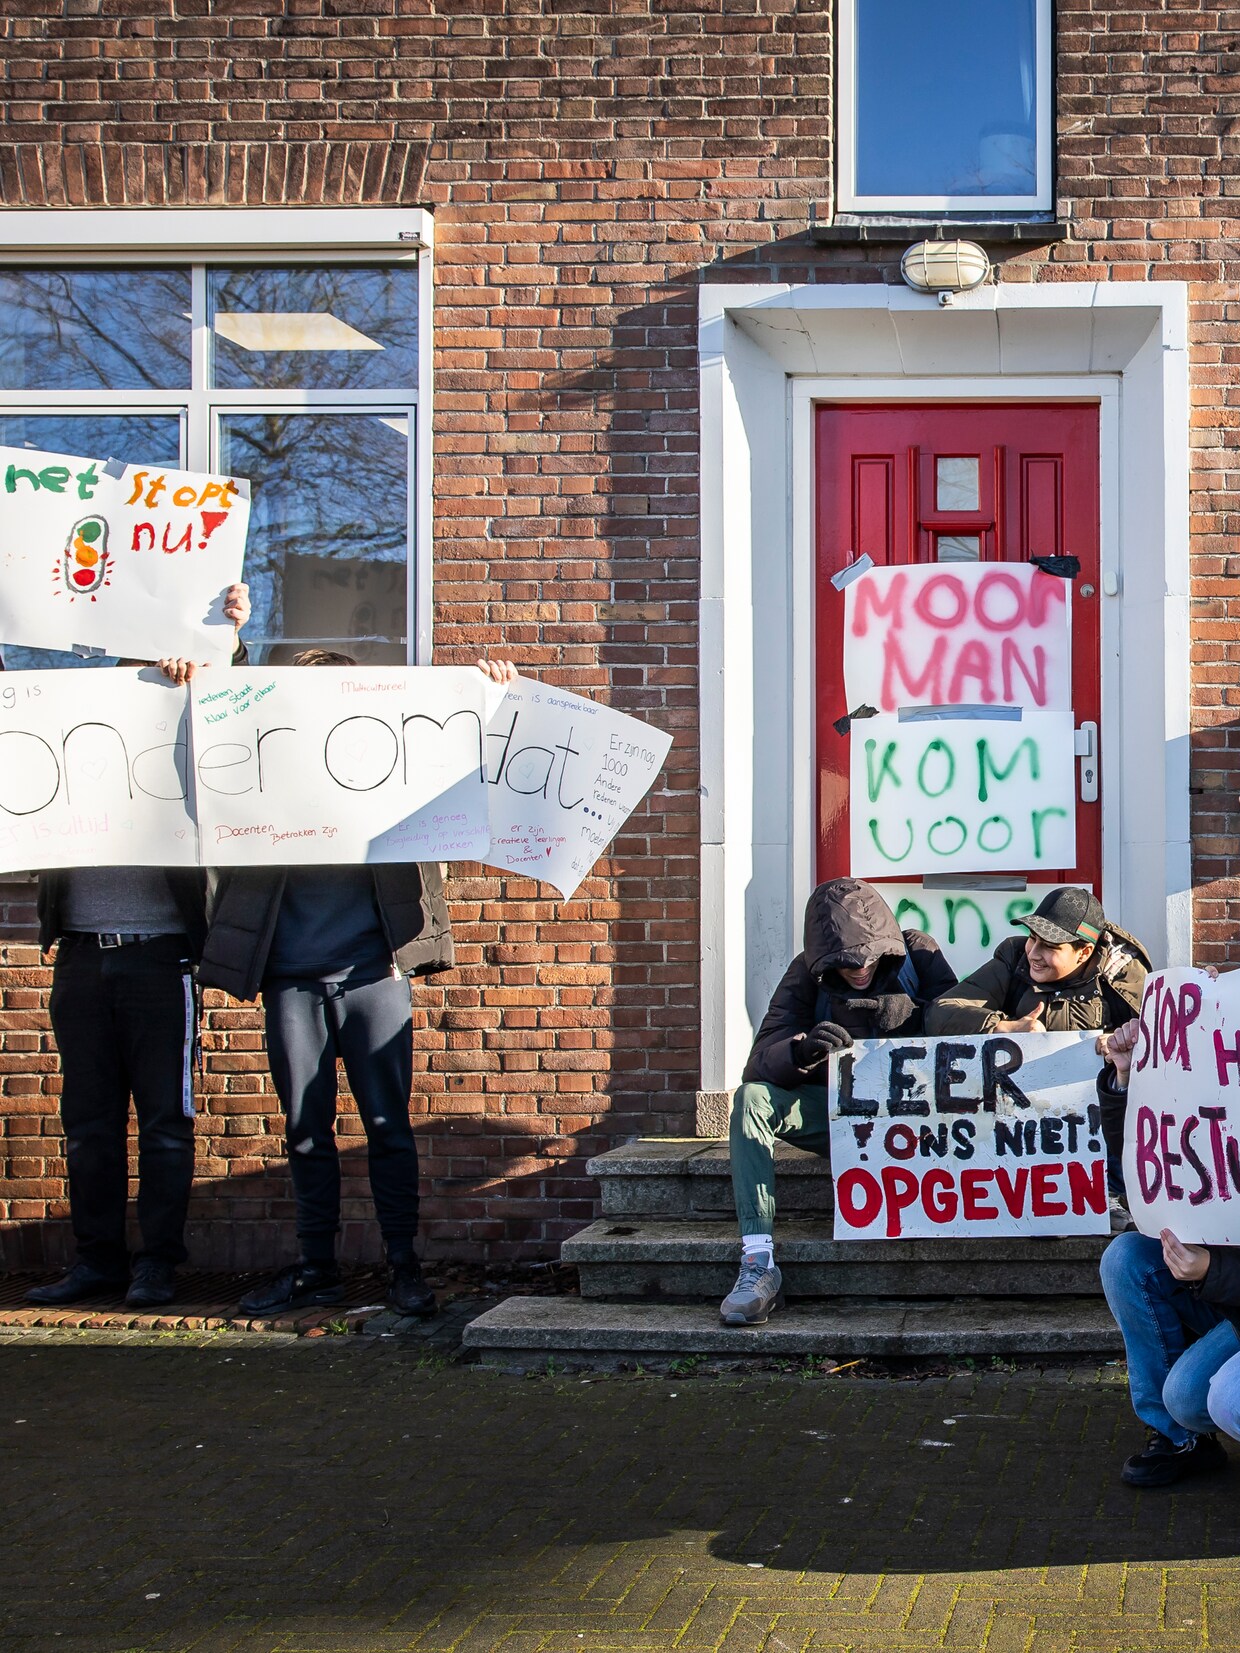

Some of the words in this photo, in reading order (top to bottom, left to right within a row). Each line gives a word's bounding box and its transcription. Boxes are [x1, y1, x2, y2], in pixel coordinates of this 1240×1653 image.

[880, 629, 1046, 711] MAN
[610, 733, 623, 751] Er
[601, 753, 628, 777] 1000
[594, 773, 622, 794] Andere
[432, 812, 469, 831] genoeg
[215, 824, 275, 845] Docenten
[505, 854, 544, 865] Docenten
[1136, 975, 1202, 1073] STOP
[837, 1037, 1032, 1117] LEER
[883, 1118, 976, 1161] ONS
[993, 1103, 1102, 1158] NIET!
[836, 1159, 1108, 1238] OPGEVEN
